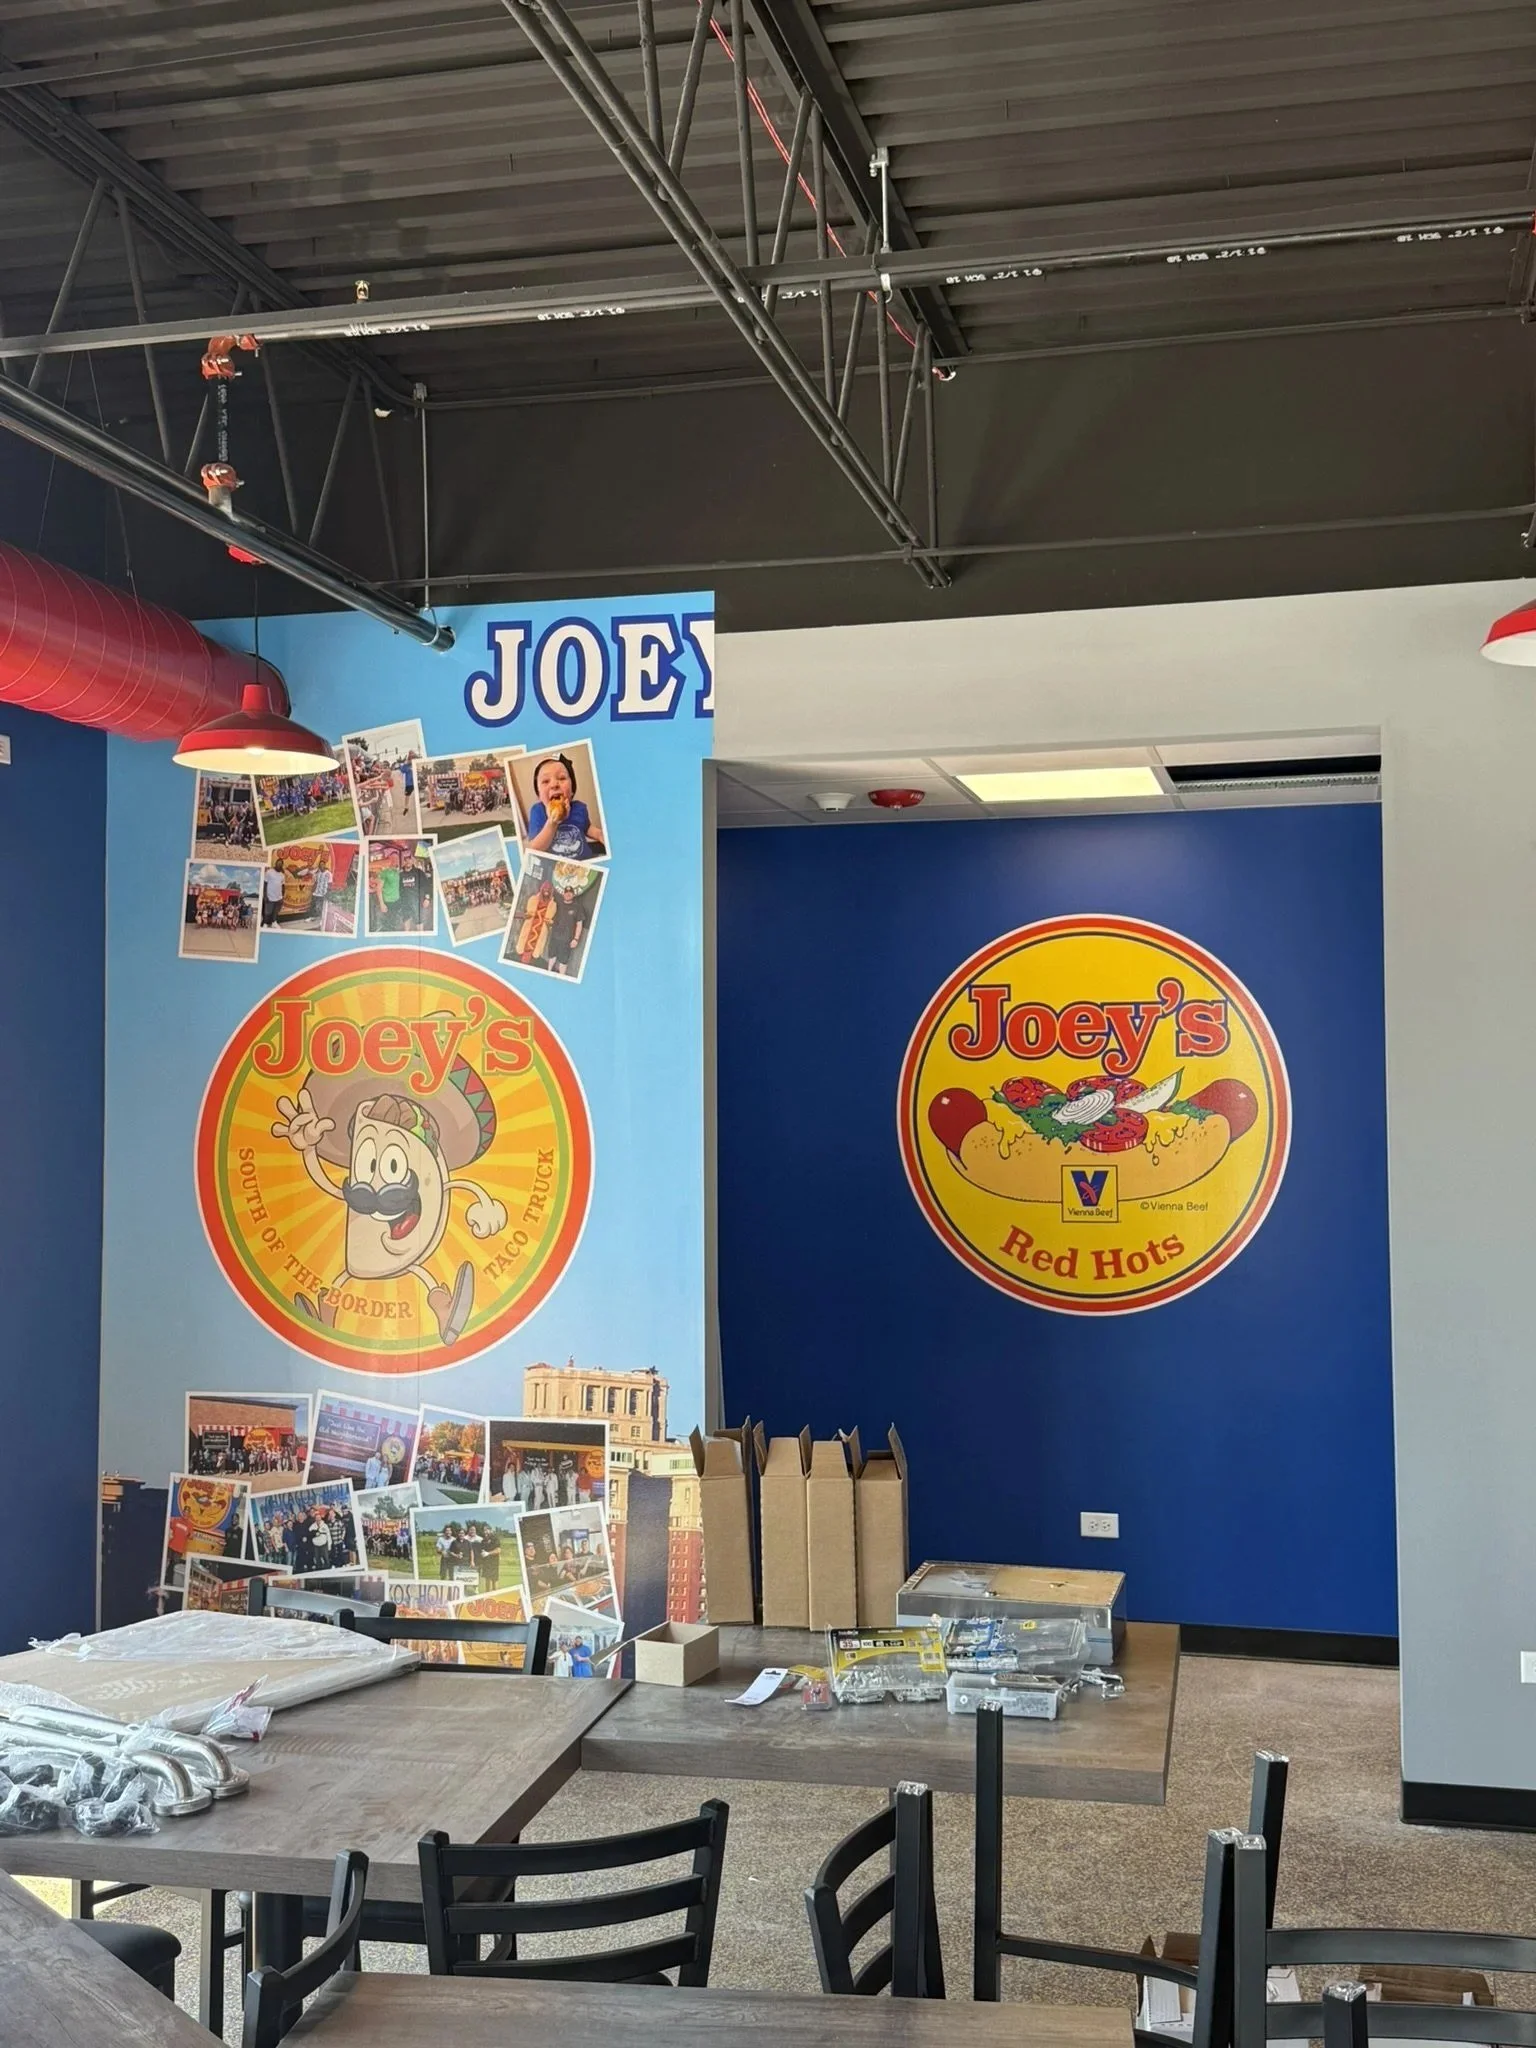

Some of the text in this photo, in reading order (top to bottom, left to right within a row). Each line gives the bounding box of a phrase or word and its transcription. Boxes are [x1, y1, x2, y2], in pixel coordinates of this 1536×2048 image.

[251, 995, 534, 1097] Joey's
[949, 978, 1230, 1077] Joey's
[239, 1148, 413, 1319] SOUTH OF THE BORDER
[483, 1148, 554, 1280] TACO TRUCK
[1000, 1224, 1185, 1280] Red Hots
[1067, 1207, 1113, 1218] Vienna Beef
[1186, 1202, 1208, 1211] Beef
